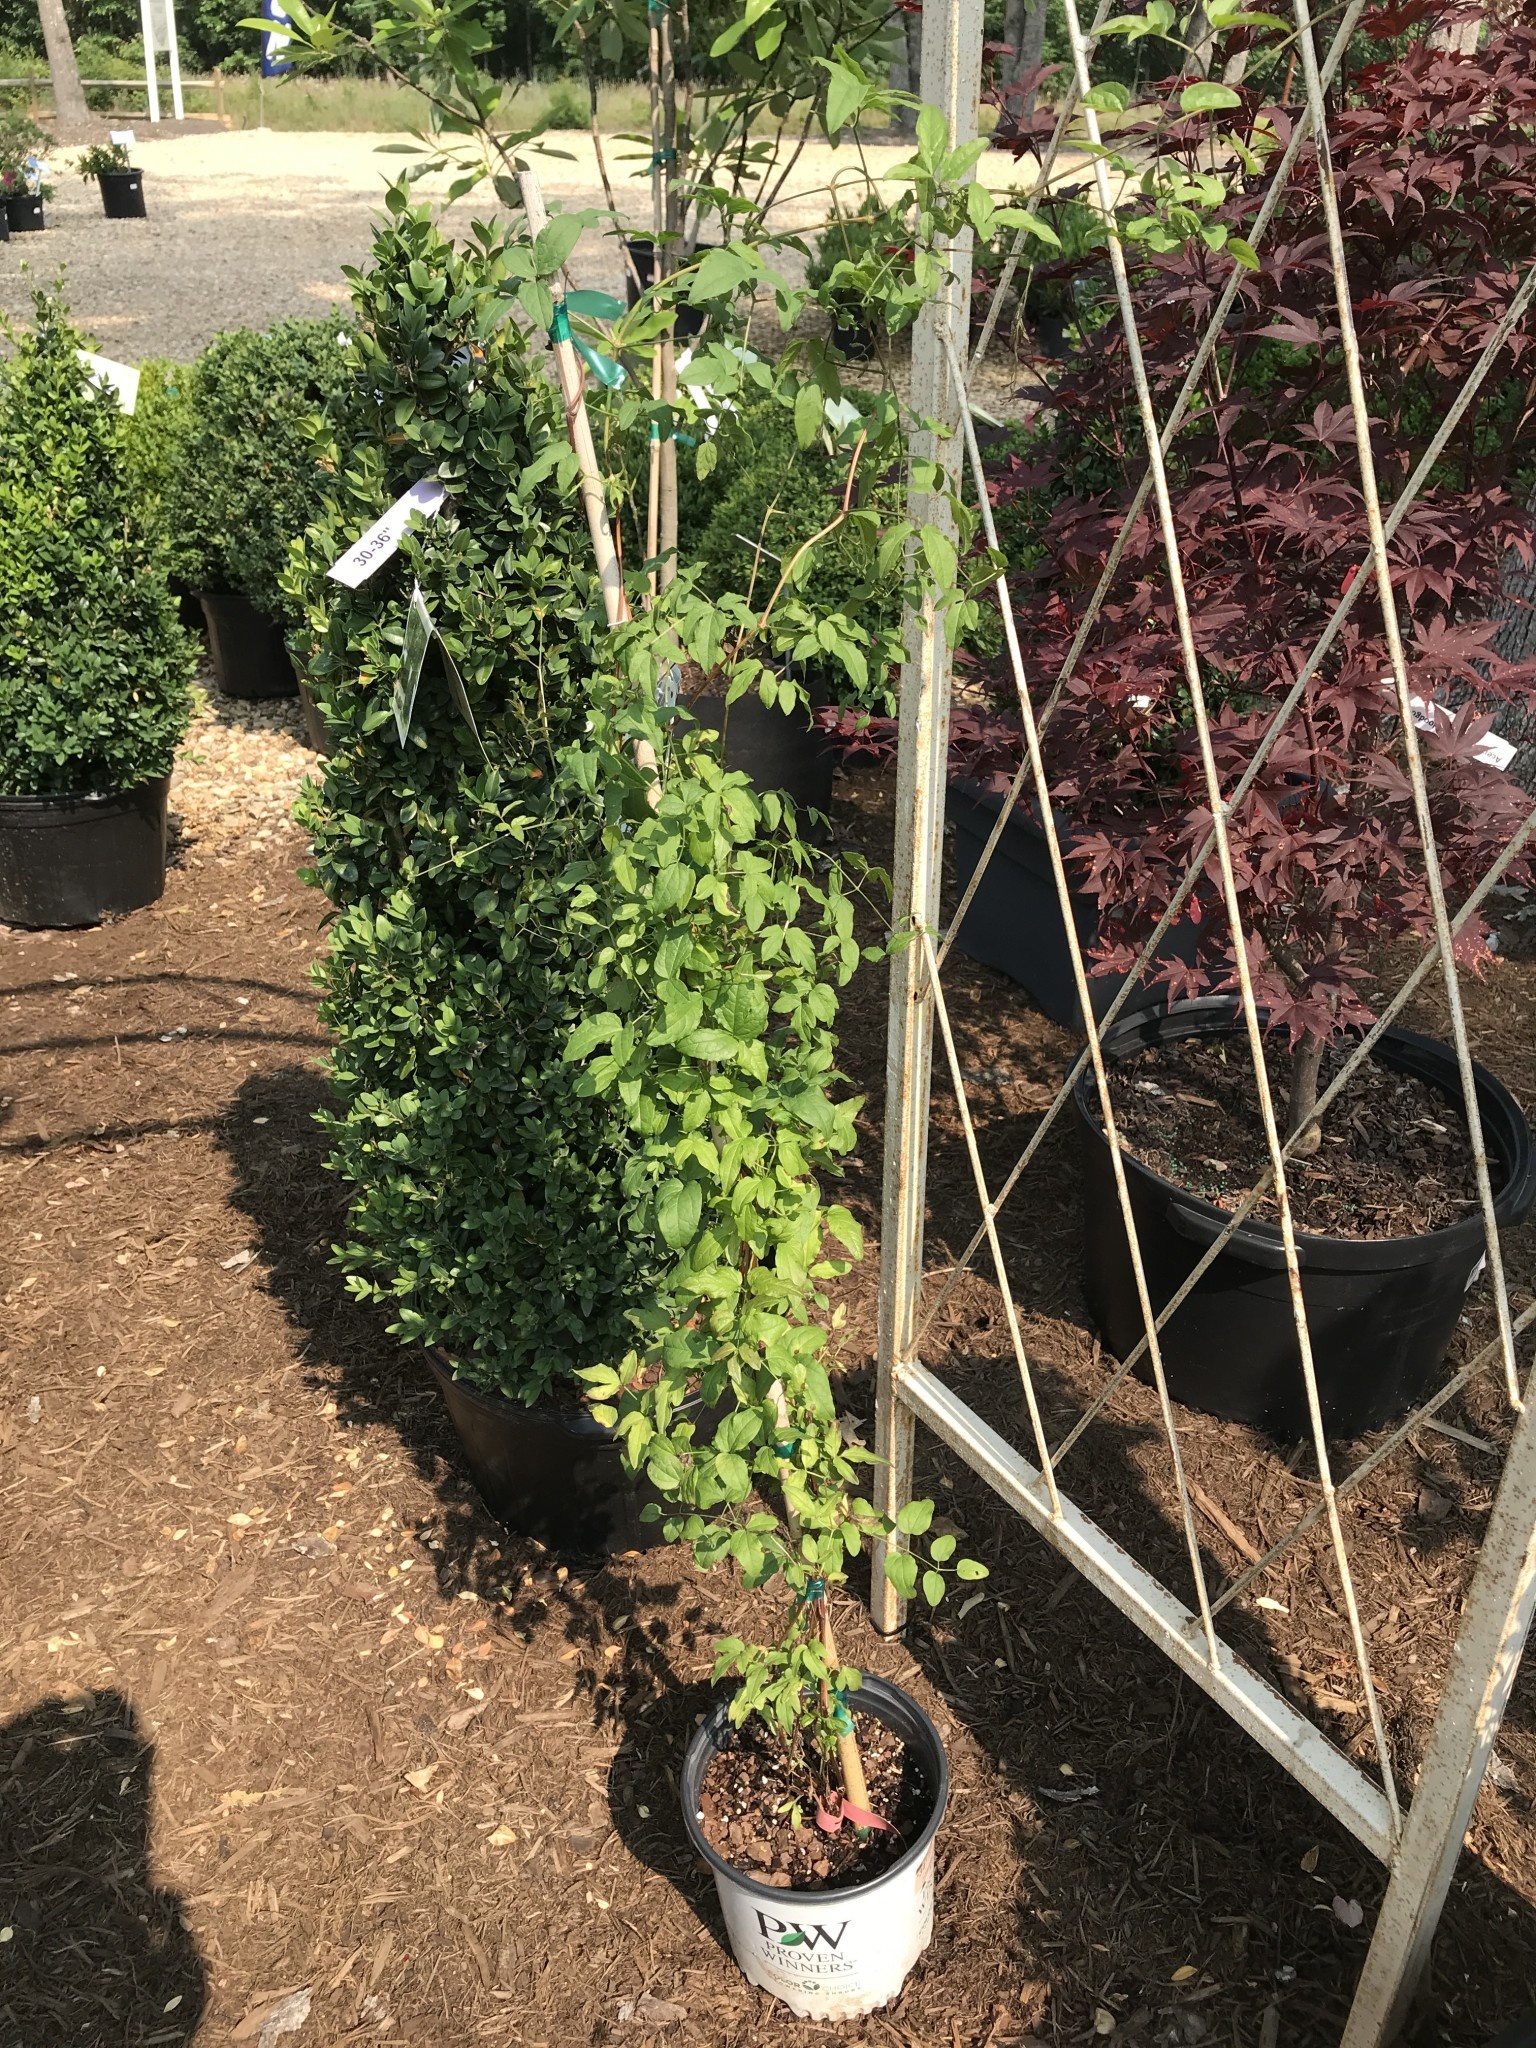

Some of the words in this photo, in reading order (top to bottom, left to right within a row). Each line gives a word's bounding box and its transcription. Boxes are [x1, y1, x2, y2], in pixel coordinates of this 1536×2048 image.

[353, 527, 391, 567] 30-36"
[751, 1906, 853, 1951] PW
[760, 1947, 855, 1974] WINNERS
[765, 1941, 845, 1963] PROVEN
